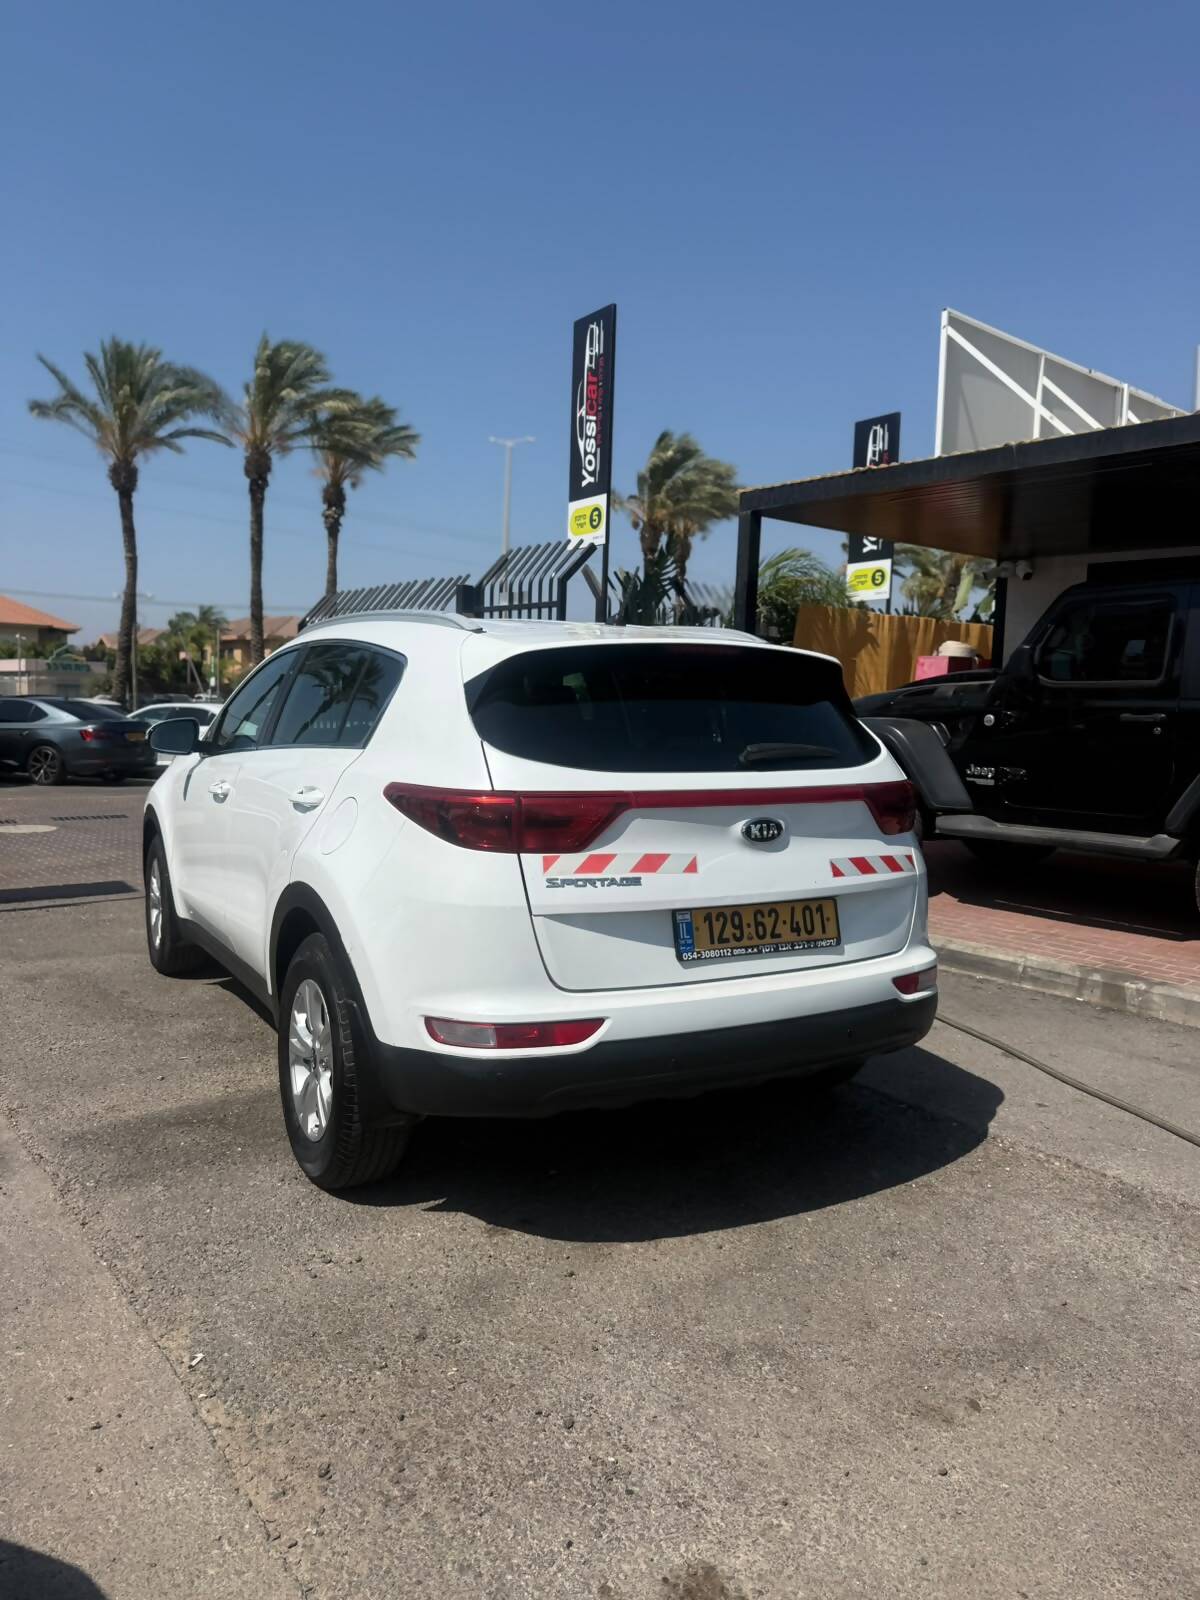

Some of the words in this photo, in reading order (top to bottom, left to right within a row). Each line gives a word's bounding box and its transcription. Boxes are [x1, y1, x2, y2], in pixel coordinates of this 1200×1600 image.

[966, 763, 996, 778] Jeep
[750, 823, 778, 839] KIA
[545, 876, 642, 888] SPORTAGE
[679, 922, 691, 939] IL
[682, 948, 732, 960] 054-3080112
